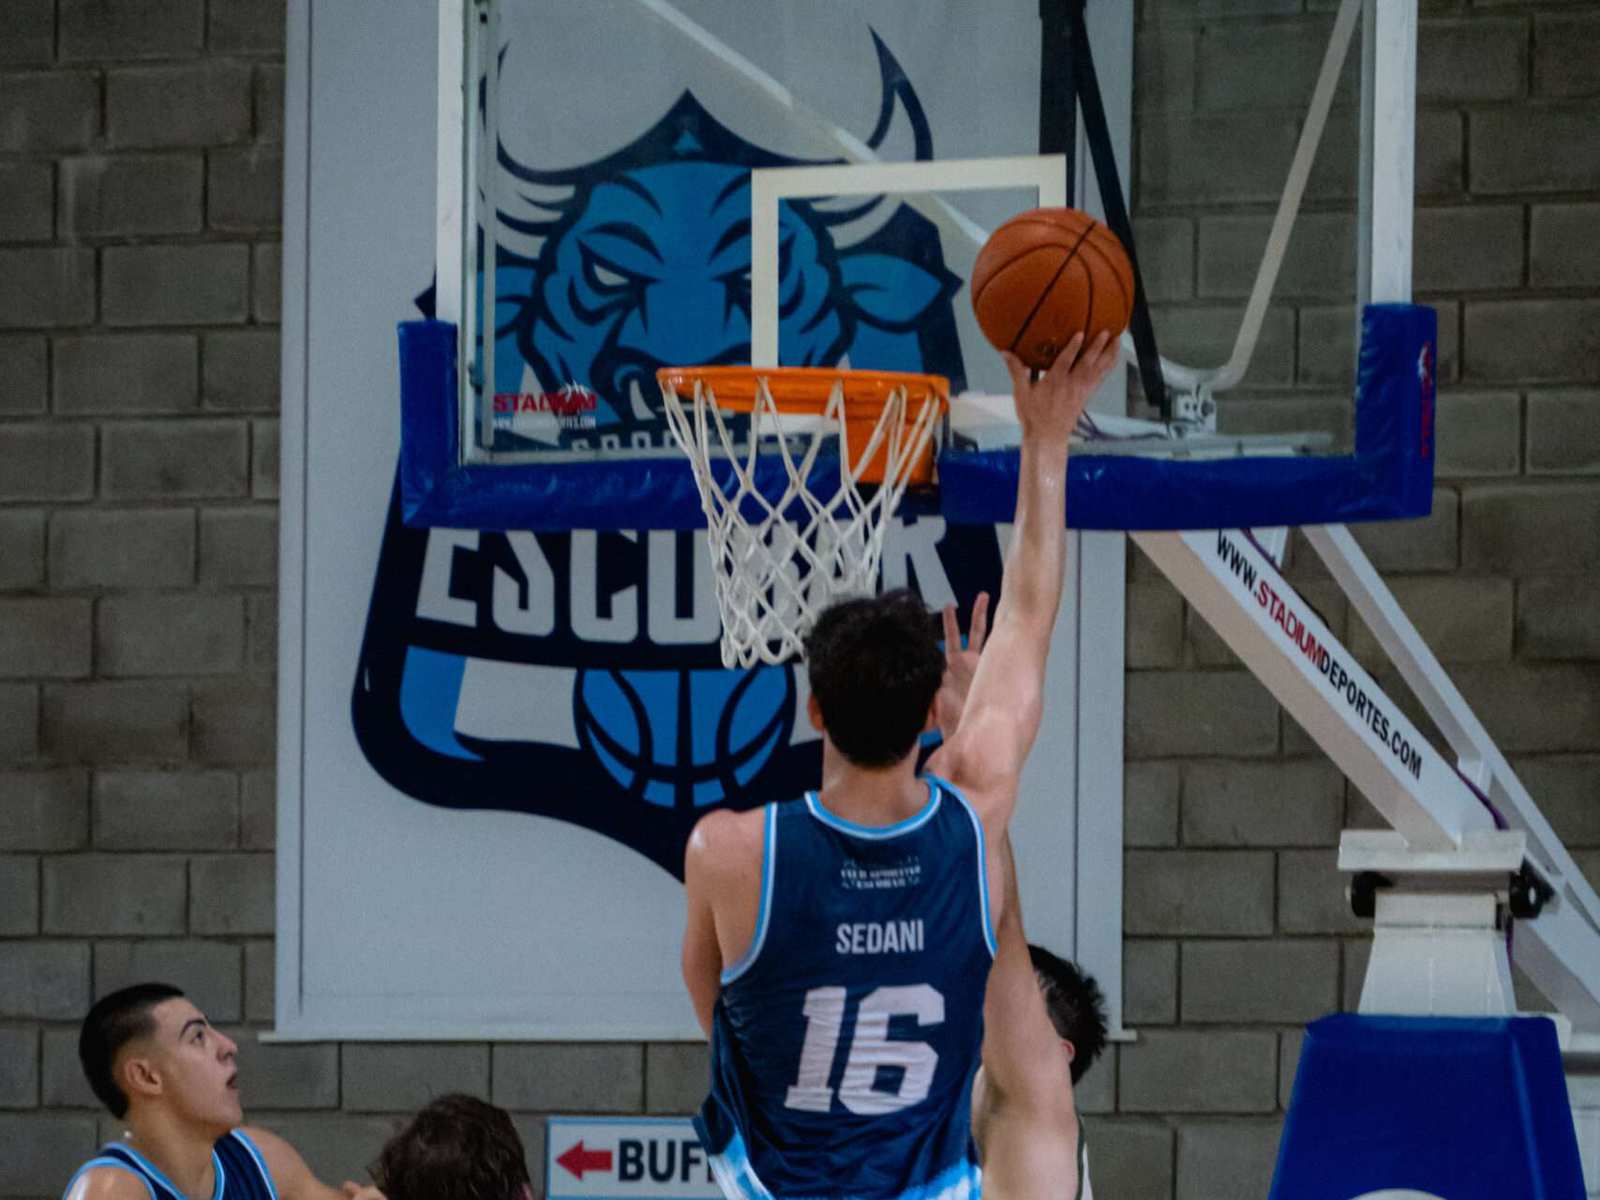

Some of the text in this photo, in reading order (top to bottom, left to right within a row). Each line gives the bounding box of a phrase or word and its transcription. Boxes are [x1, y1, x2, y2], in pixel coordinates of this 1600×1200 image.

[836, 919, 924, 954] SEDANI
[784, 983, 945, 1115] 16
[618, 1139, 714, 1182] BUF
